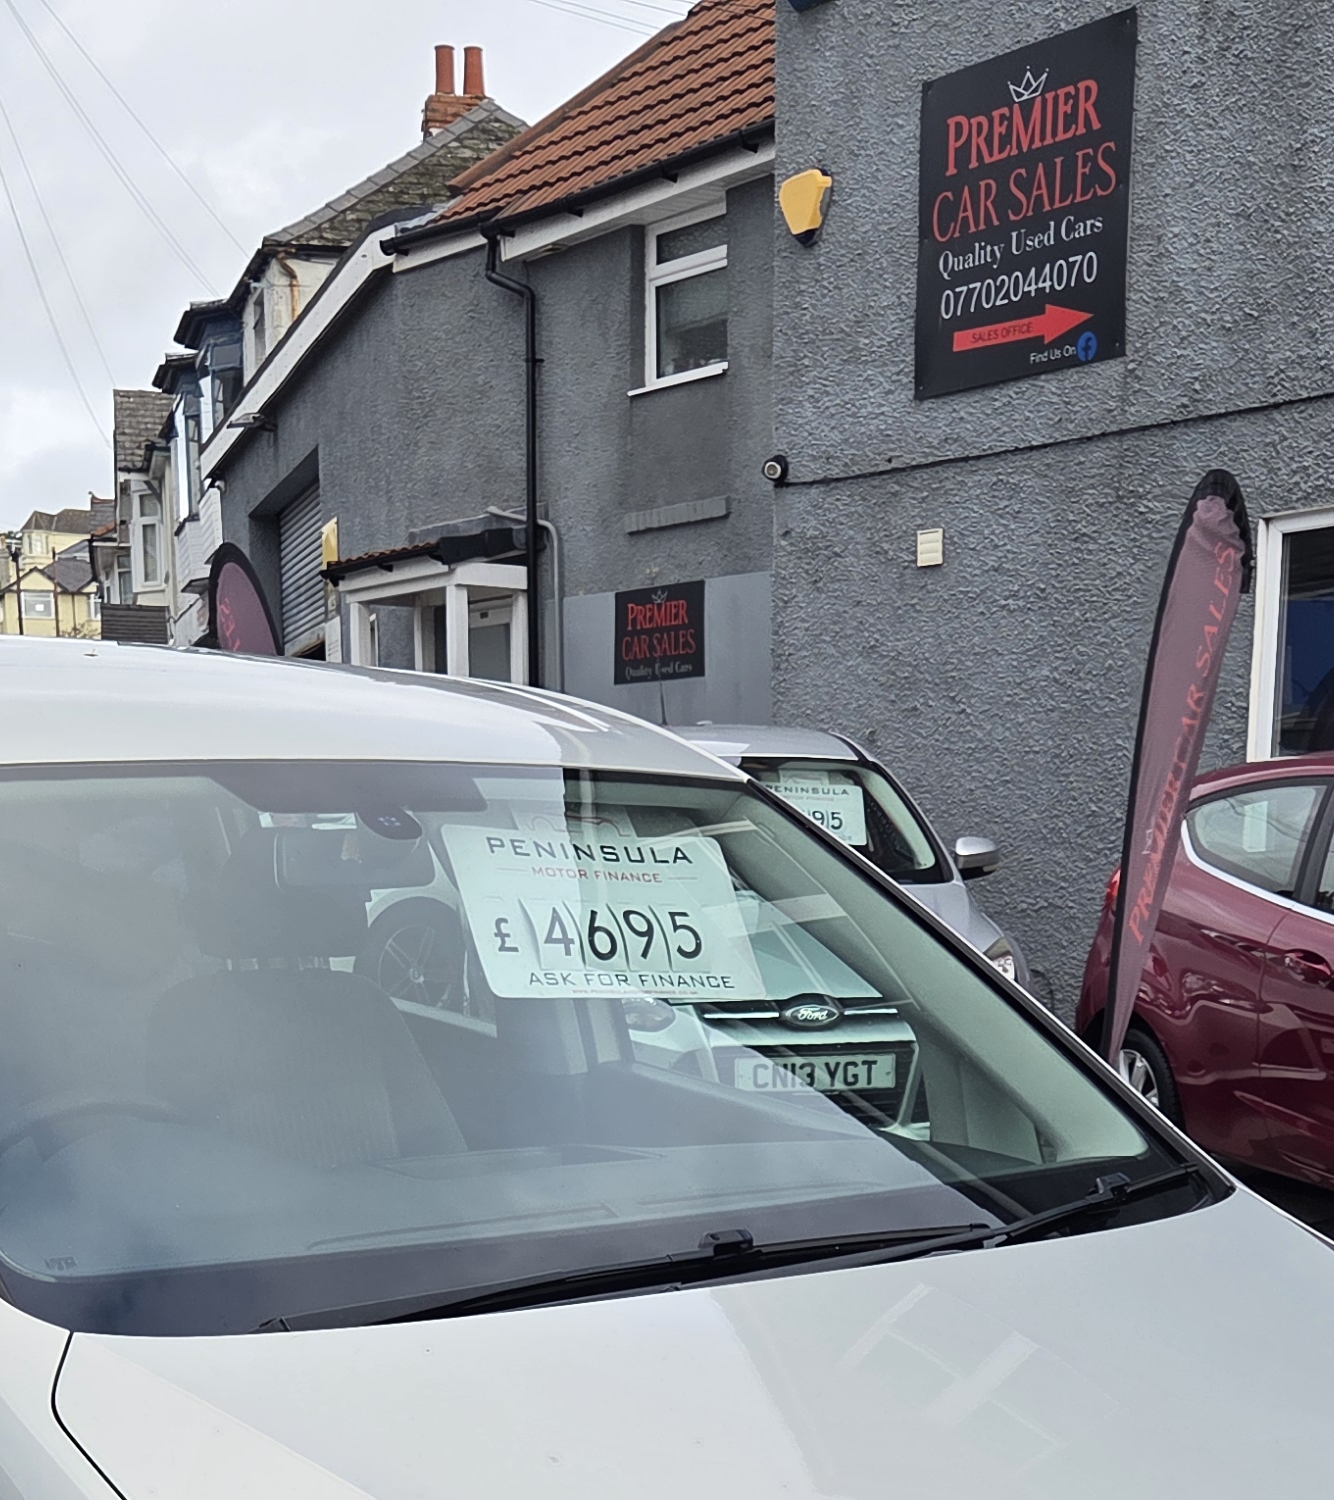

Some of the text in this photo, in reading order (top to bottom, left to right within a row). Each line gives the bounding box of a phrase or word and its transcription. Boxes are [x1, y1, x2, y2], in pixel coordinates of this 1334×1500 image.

[945, 79, 1101, 176] PREMIER
[933, 141, 1117, 242] CAR SALES
[938, 214, 1103, 279] Quality Used Cars
[940, 251, 1098, 319] 07702044070
[971, 322, 1033, 344] SALES OFFICE
[1029, 351, 1048, 364] Find
[1050, 348, 1062, 360] Us
[1063, 344, 1077, 357] On
[627, 600, 688, 630] PREMIER
[1194, 541, 1238, 681] SALES
[622, 629, 696, 661] CAR SALES
[486, 837, 693, 864] PENINSULA
[532, 866, 663, 883] MOTOR FINANCE
[543, 909, 703, 961] 4695
[529, 971, 736, 990] ASK FOR FINANCE
[797, 1007, 828, 1020] Ford
[752, 1060, 878, 1089] CN13 YGT
